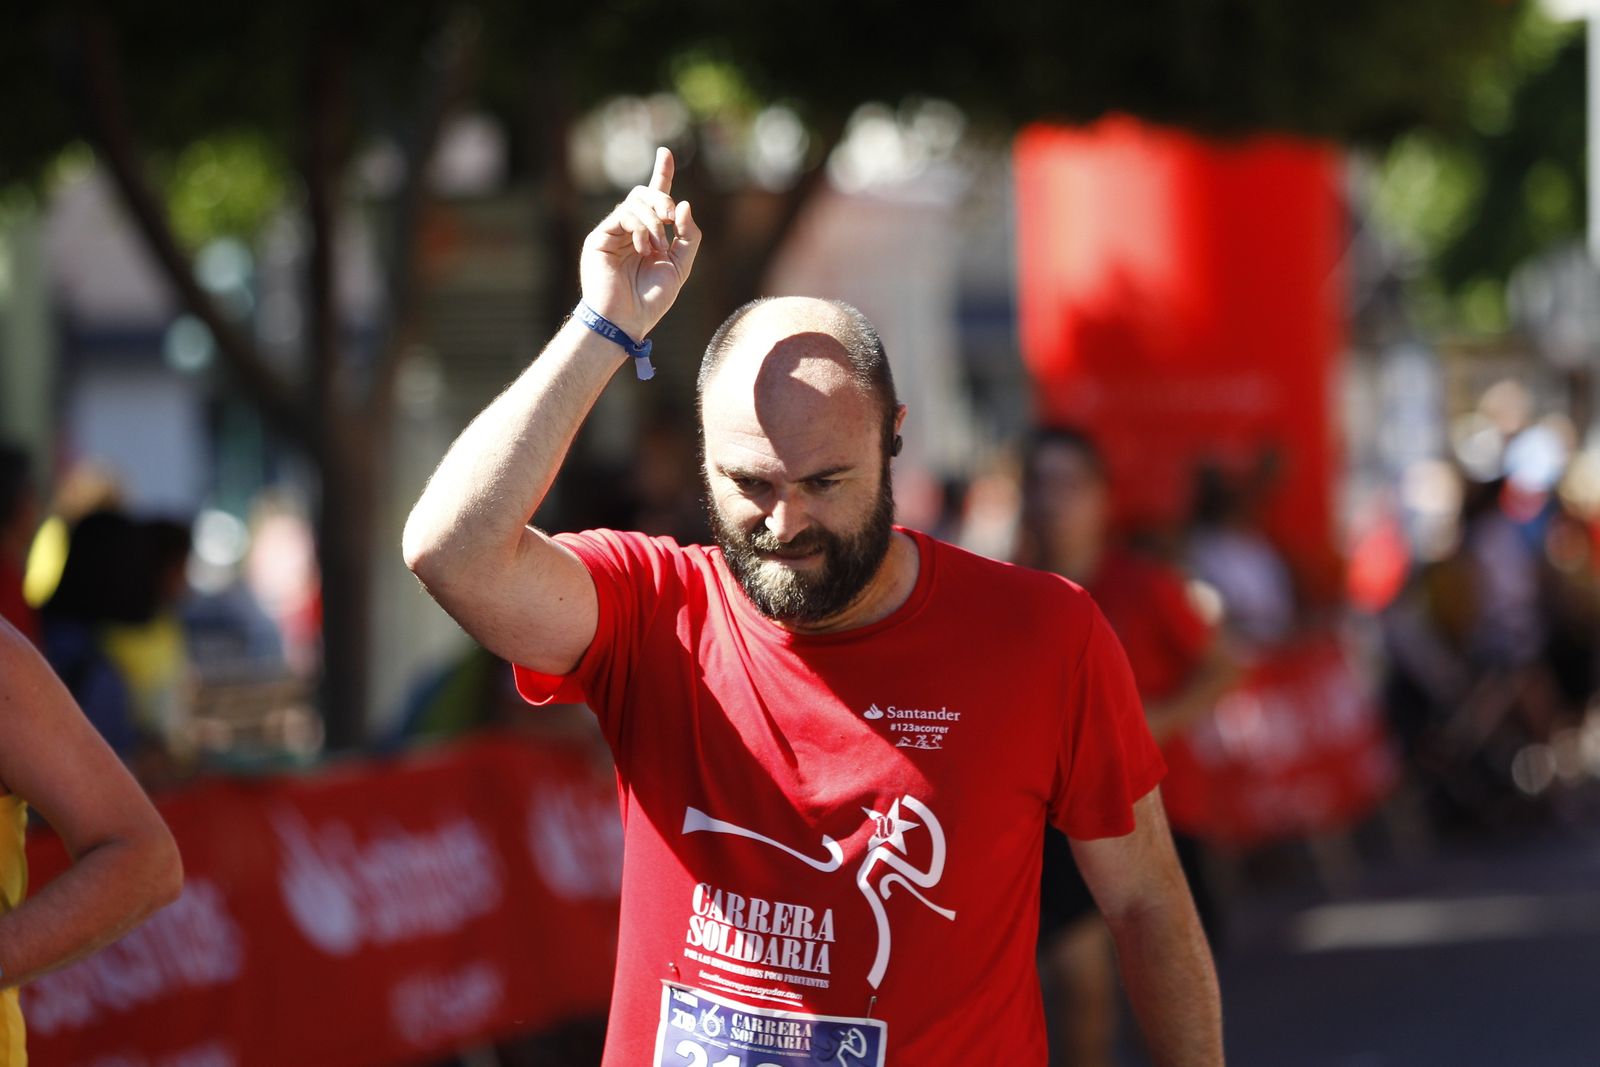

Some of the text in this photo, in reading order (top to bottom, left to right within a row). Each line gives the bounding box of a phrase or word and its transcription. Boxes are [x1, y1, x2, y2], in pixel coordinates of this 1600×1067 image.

[887, 706, 961, 721] Santander
[890, 723, 949, 734] #123acorrer
[692, 882, 836, 942] CARRERA
[686, 915, 831, 975] SOLIDARIA
[731, 1013, 812, 1038] CARRERA
[730, 1028, 811, 1051] SOLIDARIA
